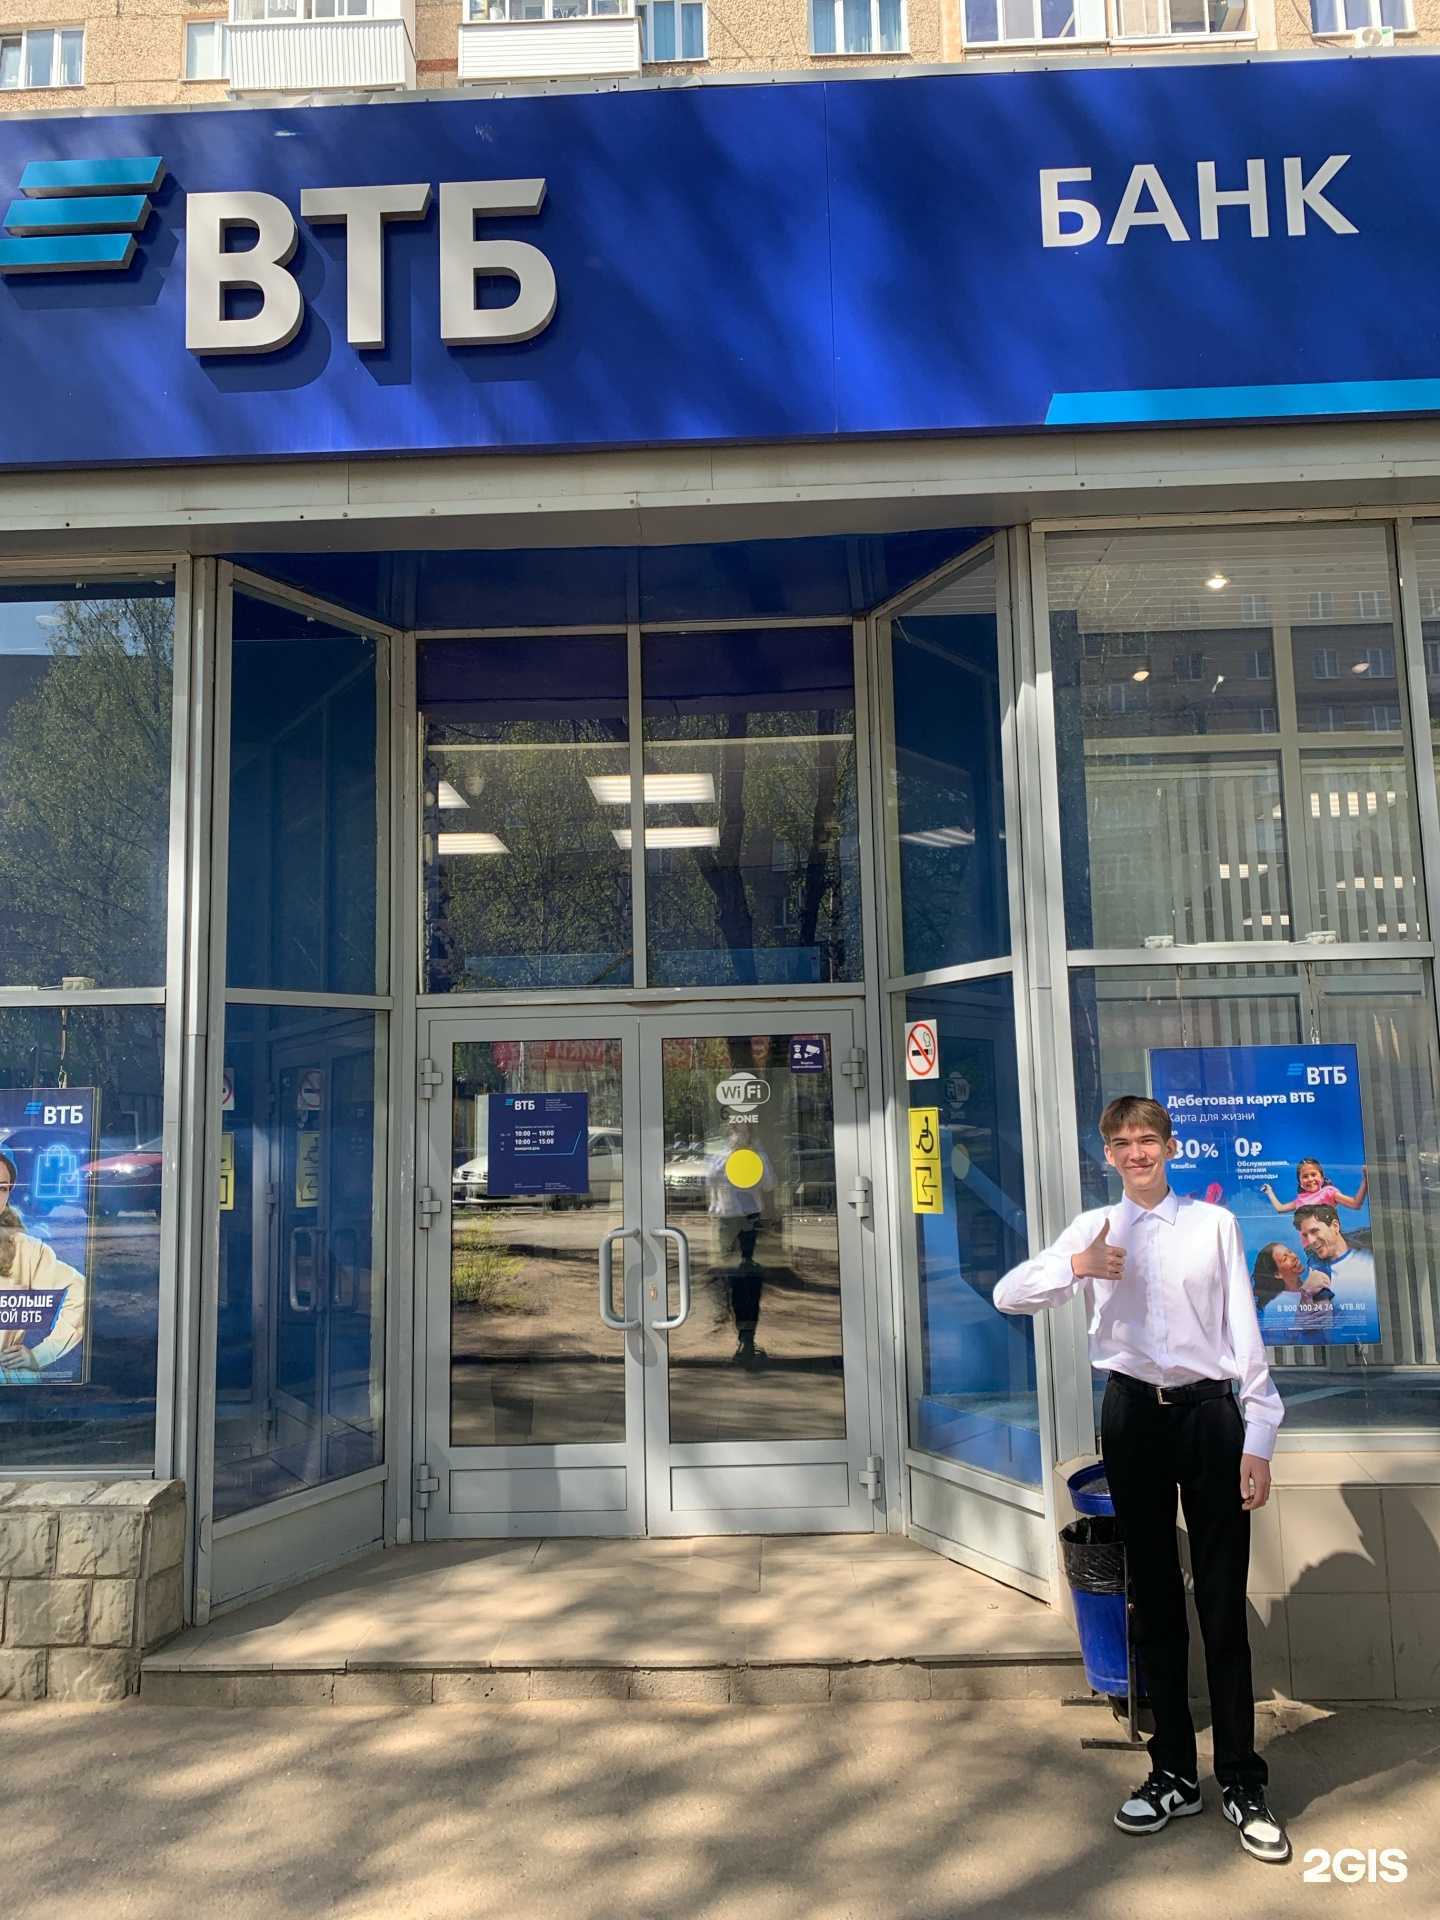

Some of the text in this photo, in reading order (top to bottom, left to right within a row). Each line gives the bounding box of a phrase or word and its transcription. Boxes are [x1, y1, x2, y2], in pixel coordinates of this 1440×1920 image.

[1039, 154, 1360, 248] БАНК
[186, 178, 557, 356] ВТБ
[1307, 1065, 1347, 1086] ВТБ
[721, 1084, 761, 1099] WiFi
[514, 1100, 536, 1111] ВТБ
[1167, 1092, 1315, 1109] Дебетовая карта ВТБ
[43, 1105, 83, 1125] ВТБ
[728, 1115, 759, 1124] ZONE
[1200, 1113, 1219, 1123] для
[1221, 1112, 1255, 1121] жизни
[0, 1295, 53, 1308] БОЛЬШЕ
[0, 1307, 42, 1323] ОЙ ВТБ
